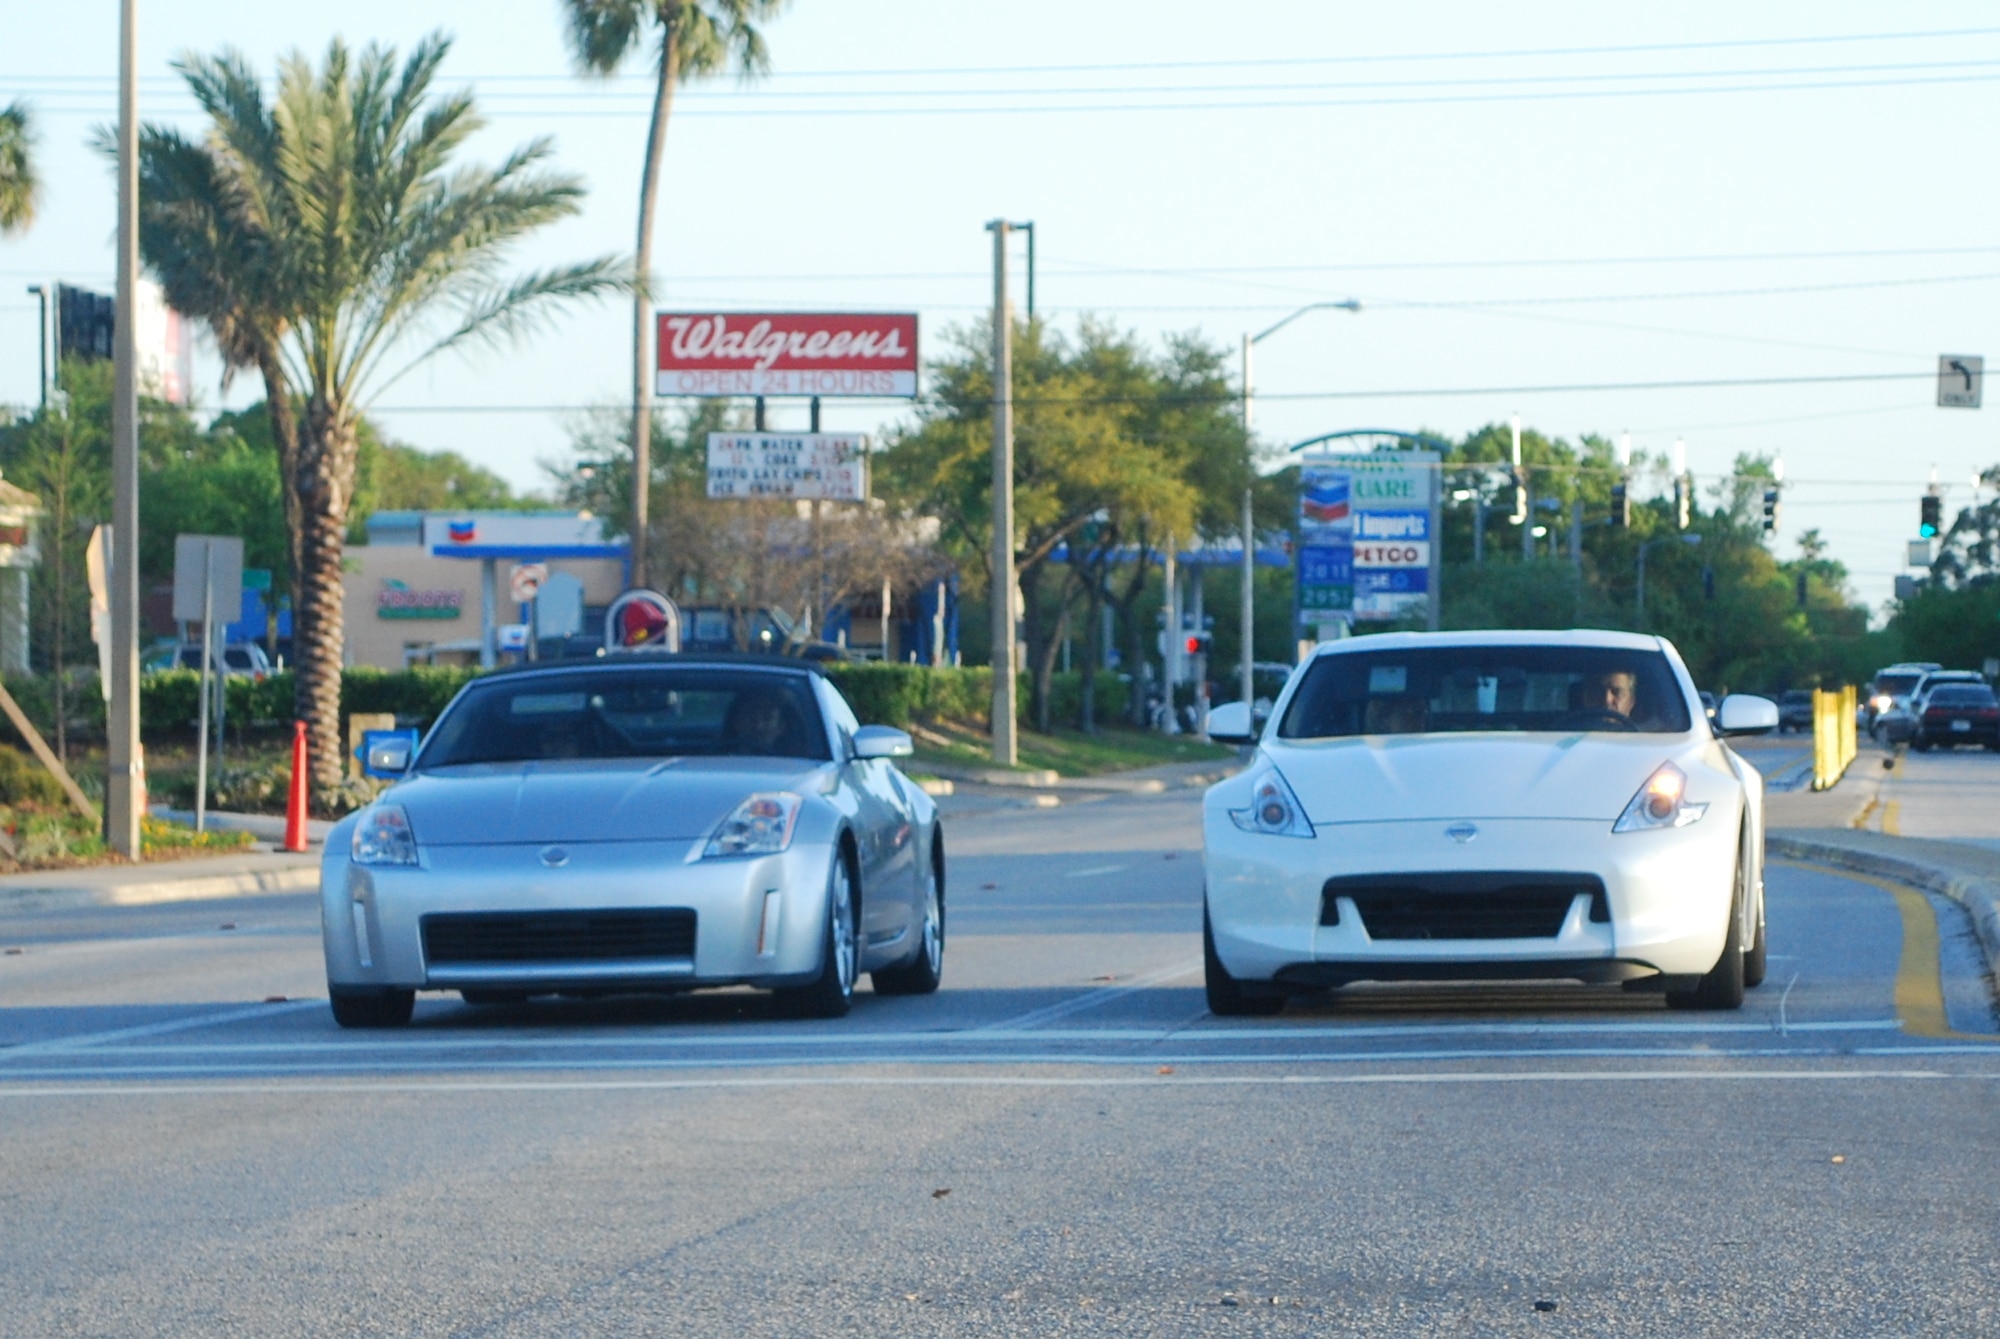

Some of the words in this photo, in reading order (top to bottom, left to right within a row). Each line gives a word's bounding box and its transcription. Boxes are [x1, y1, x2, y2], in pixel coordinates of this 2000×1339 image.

[667, 315, 908, 370] Walgreens
[677, 371, 751, 393] OPEN
[763, 371, 789, 393] 24
[800, 371, 895, 393] HOURS
[761, 439, 803, 449] WATER
[1362, 512, 1424, 538] Imports
